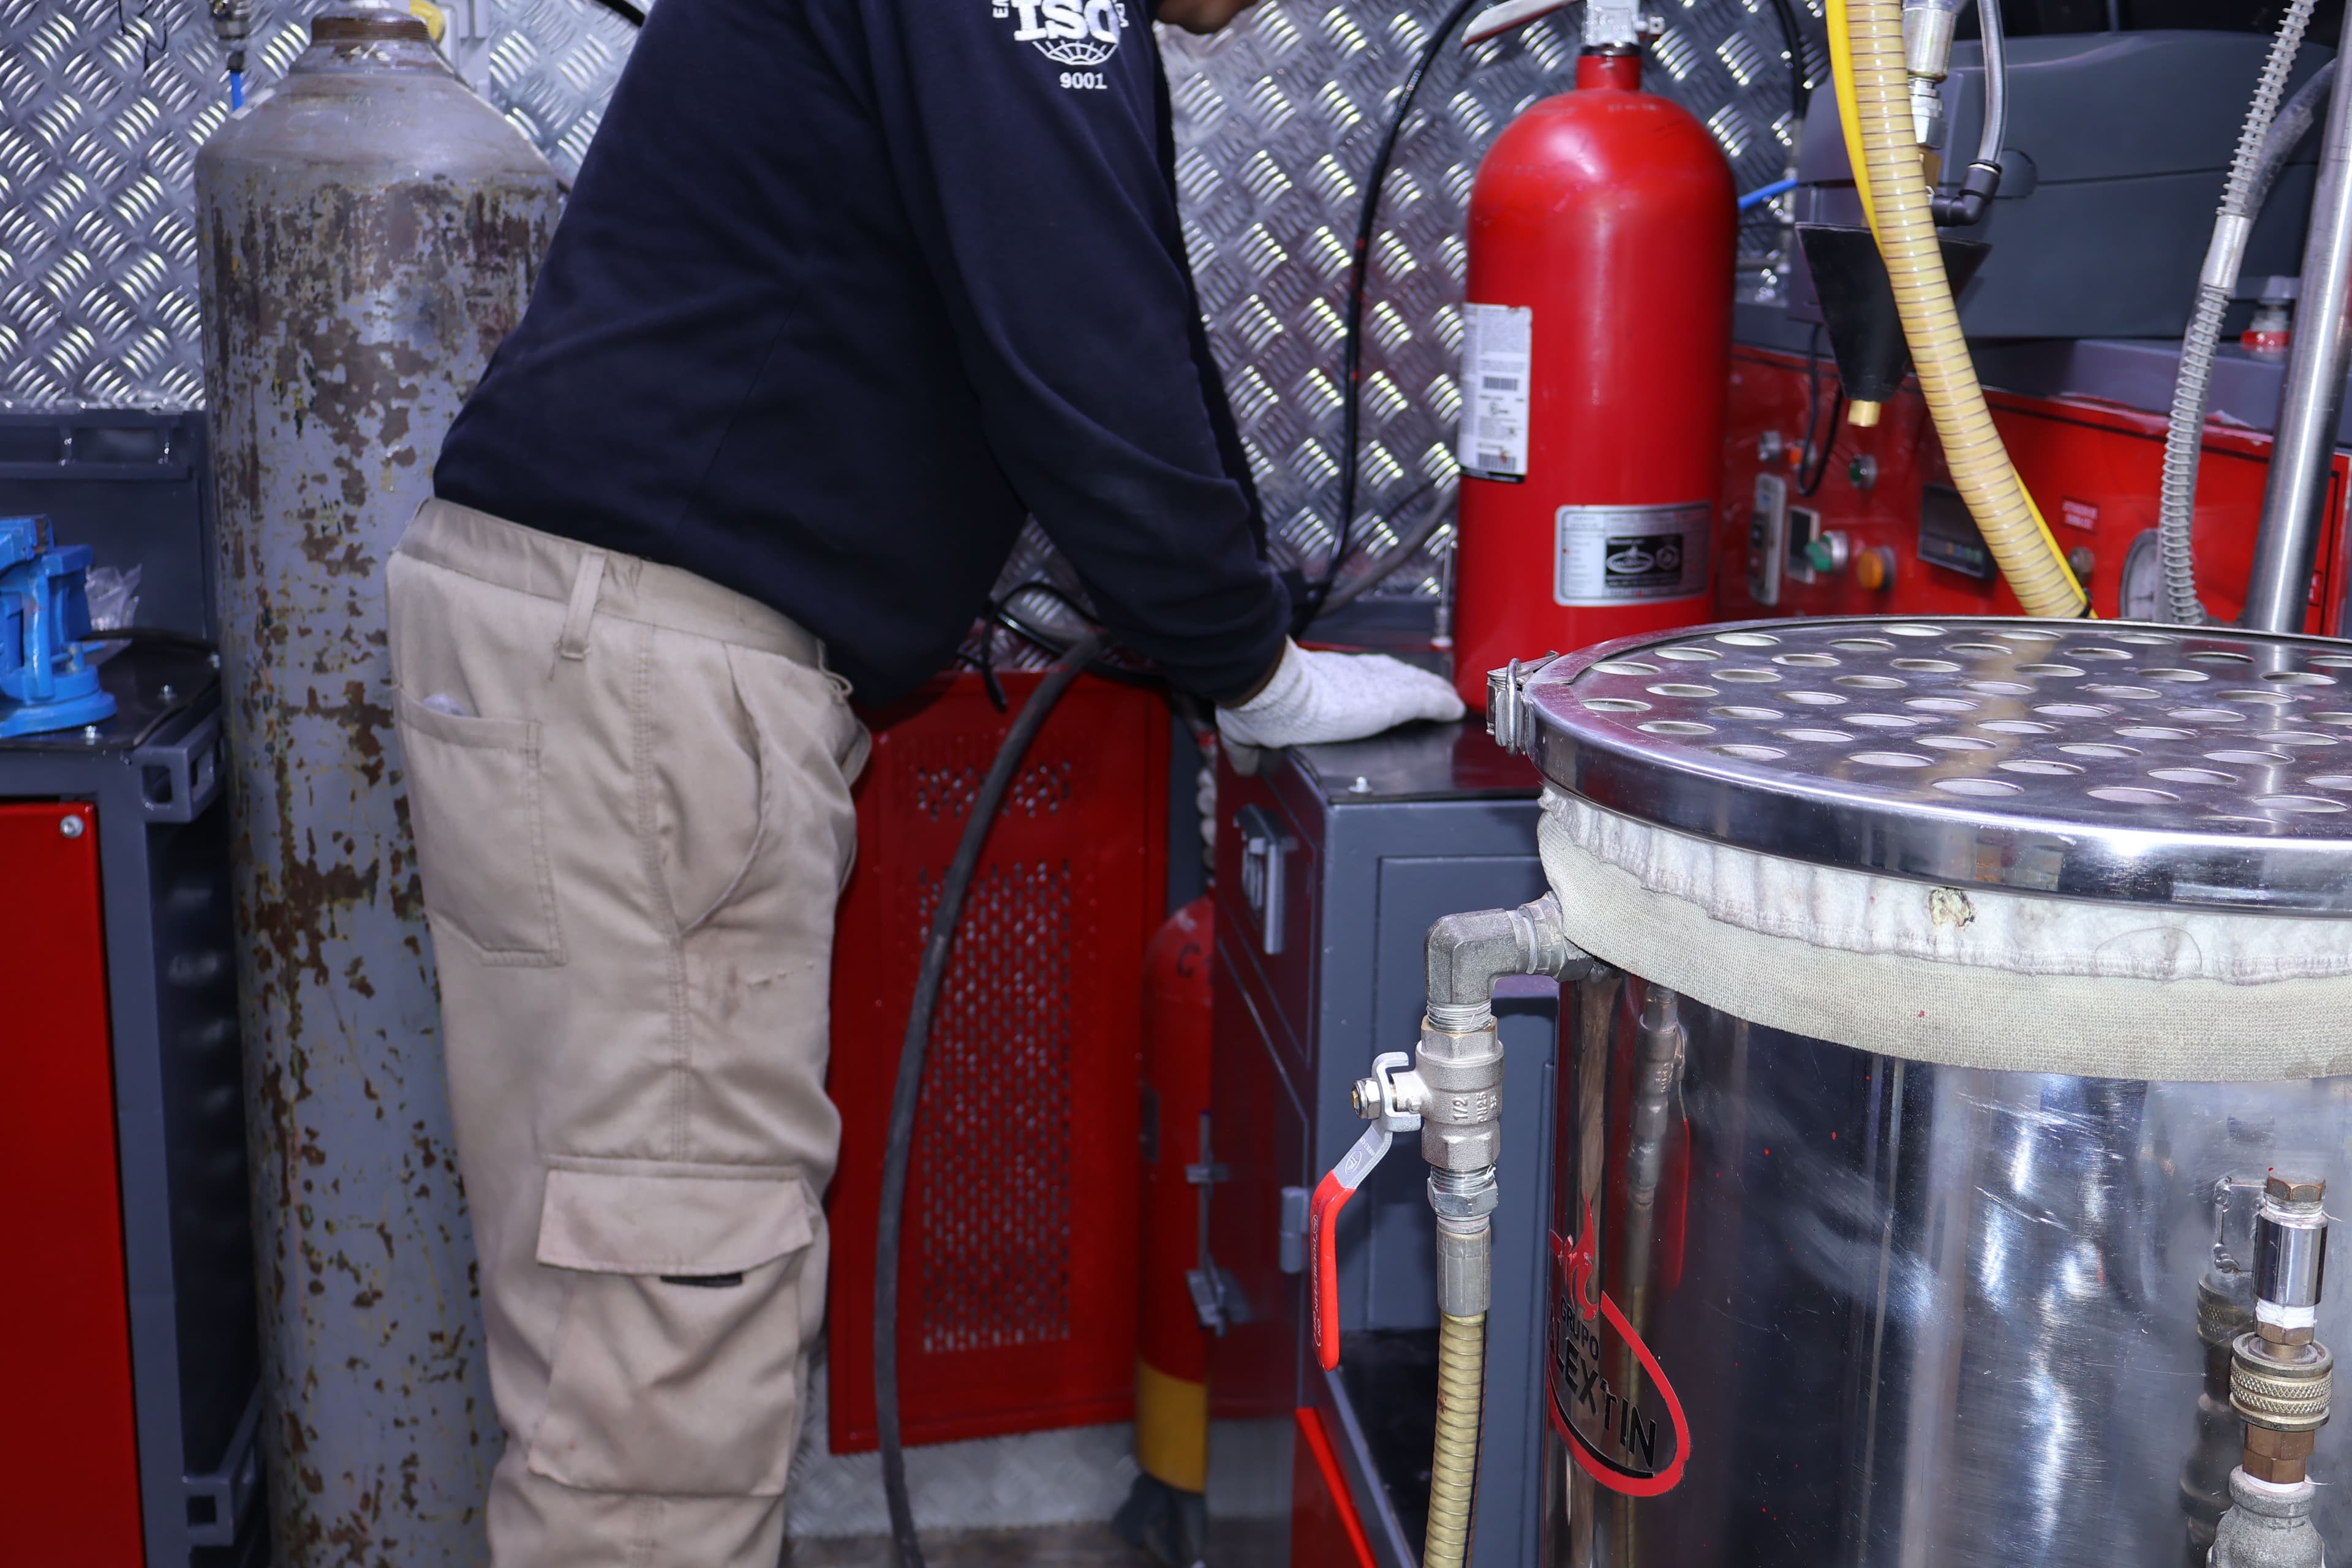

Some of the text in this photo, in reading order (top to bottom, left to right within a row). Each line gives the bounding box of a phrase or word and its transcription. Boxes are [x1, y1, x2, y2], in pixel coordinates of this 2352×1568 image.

[1011, 0, 1121, 44] ISO
[1060, 72, 1107, 89] 9001
[1452, 1097, 1468, 1120] 1/2
[1561, 1295, 1600, 1361] GRUPO
